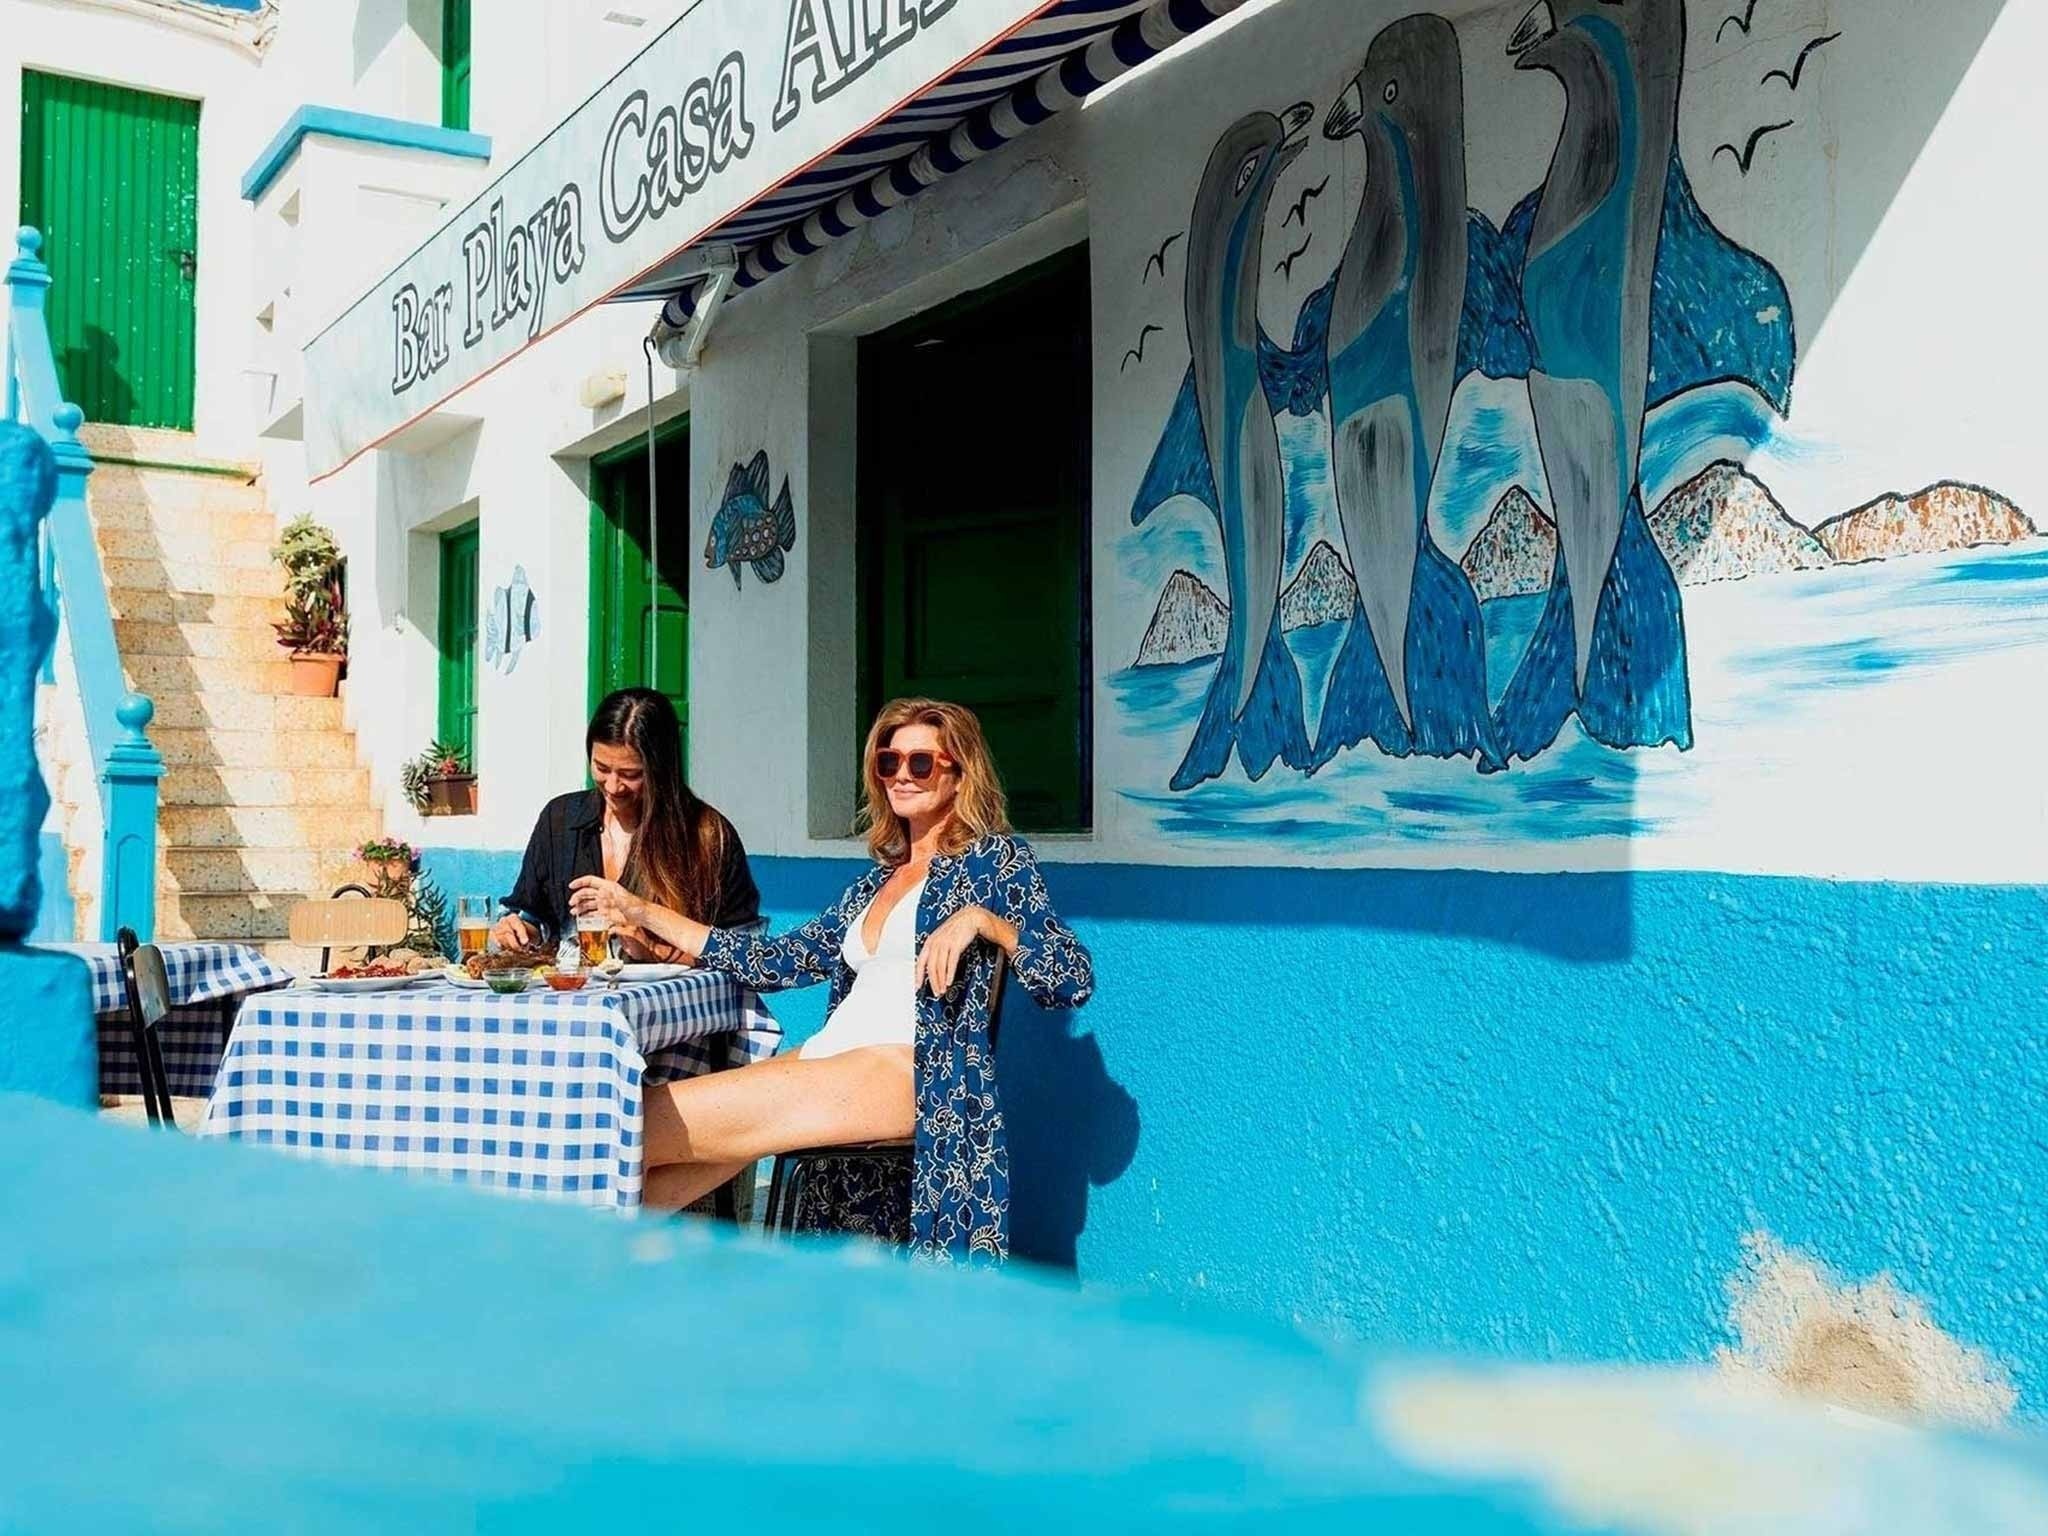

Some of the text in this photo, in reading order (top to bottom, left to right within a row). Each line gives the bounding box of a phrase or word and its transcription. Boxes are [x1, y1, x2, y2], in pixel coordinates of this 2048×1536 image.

[392, 283, 452, 395] Bar
[463, 182, 585, 349] Playa
[600, 51, 755, 243] Casa
